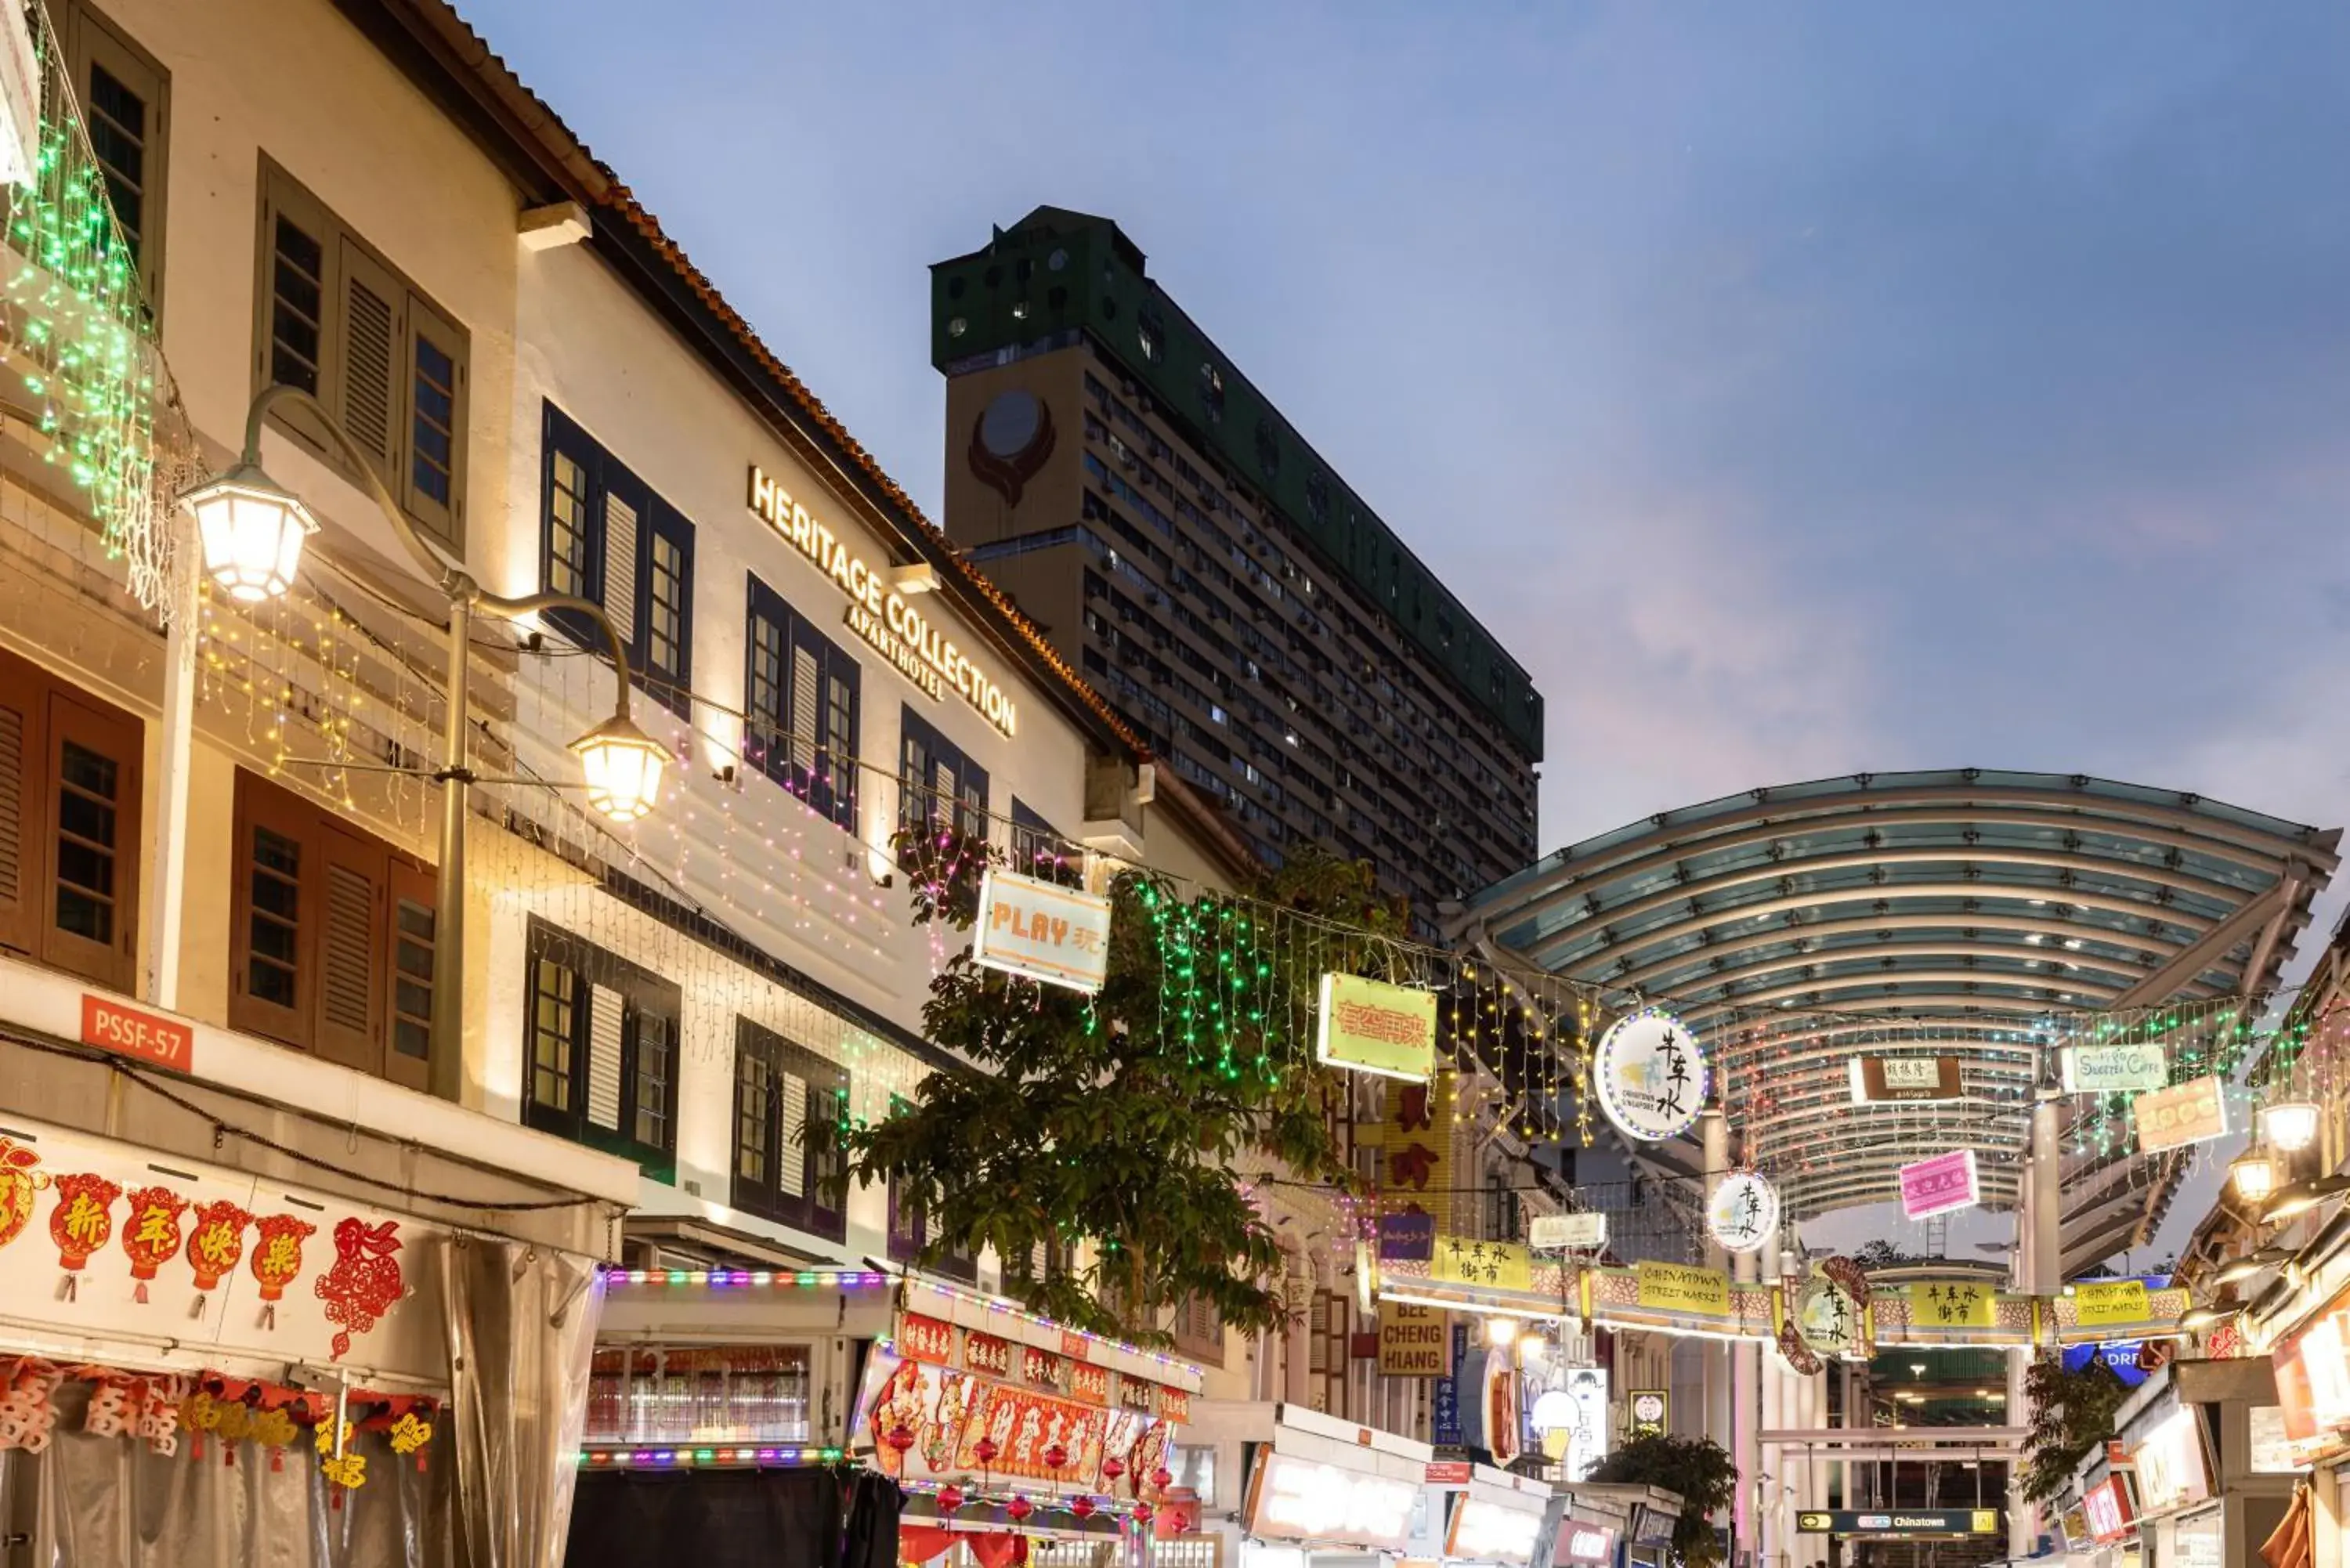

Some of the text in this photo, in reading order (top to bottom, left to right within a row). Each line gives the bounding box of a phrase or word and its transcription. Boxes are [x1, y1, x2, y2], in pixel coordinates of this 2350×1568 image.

[752, 467, 1016, 736] HERITAGE COLLECTION
[846, 606, 945, 702] APARTHOTEL
[992, 902, 1068, 947] PLAY
[95, 1009, 181, 1060] PSSF-57
[1337, 1000, 1426, 1049] 有空再来
[1644, 1268, 1722, 1286] CHINATOWN
[1398, 1302, 1428, 1317] BEE
[1385, 1325, 1441, 1343] CHENG
[1385, 1350, 1439, 1369] HIANG
[1894, 1516, 1945, 1526] Chinatown
